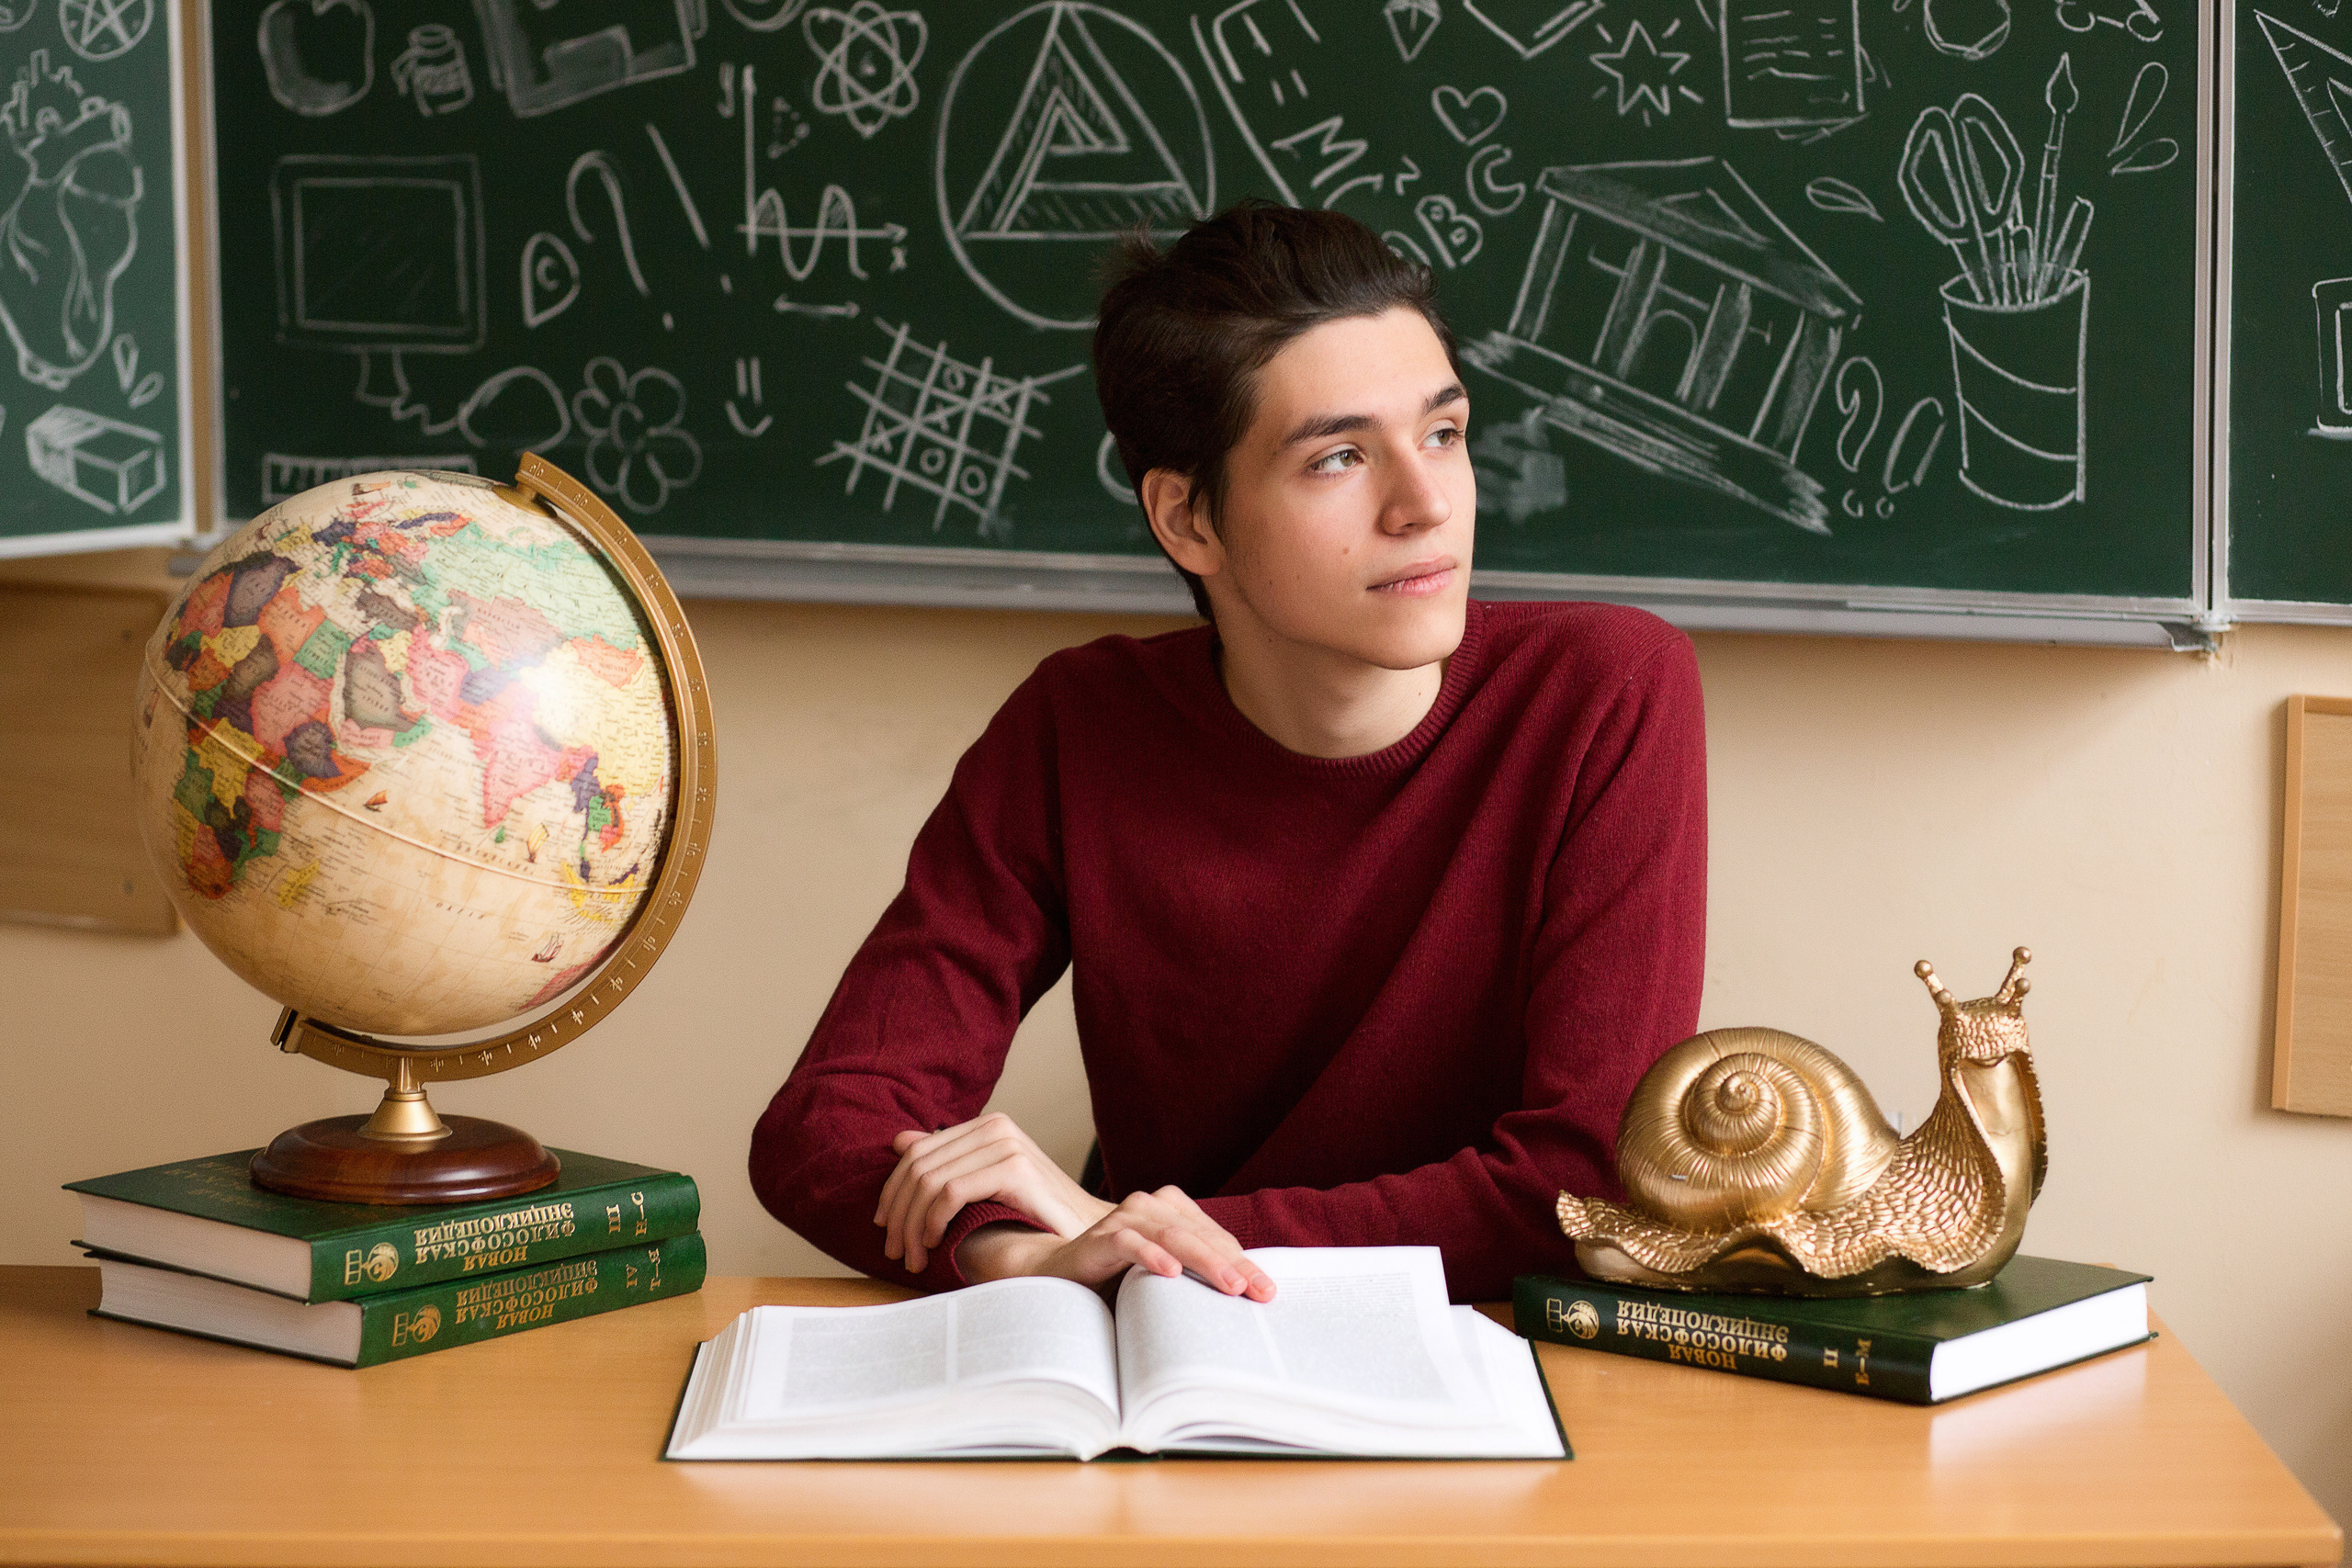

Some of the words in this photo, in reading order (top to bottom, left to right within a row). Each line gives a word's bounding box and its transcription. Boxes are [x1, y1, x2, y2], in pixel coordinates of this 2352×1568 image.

[413, 1202, 574, 1247] ЭНЦИКЛОПЕДИЯ
[605, 1203, 621, 1235] III
[415, 1219, 576, 1265] ФИЛОСОФСКАЯ
[462, 1245, 528, 1272] НОВАЯ
[456, 1259, 598, 1308] ЭНЦИКЛОПЕДИЯ
[626, 1263, 639, 1289] IV
[455, 1276, 598, 1325] ФИЛОСОФСКАЯ
[496, 1303, 556, 1330] НОВАЯ
[1616, 1300, 1790, 1344] ЭНЦИКЛОПЕДИЯ
[1616, 1317, 1788, 1362] ФИЛОСОФСКАЯ
[1668, 1343, 1738, 1370] НОВАЯ
[1823, 1347, 1839, 1369] II
